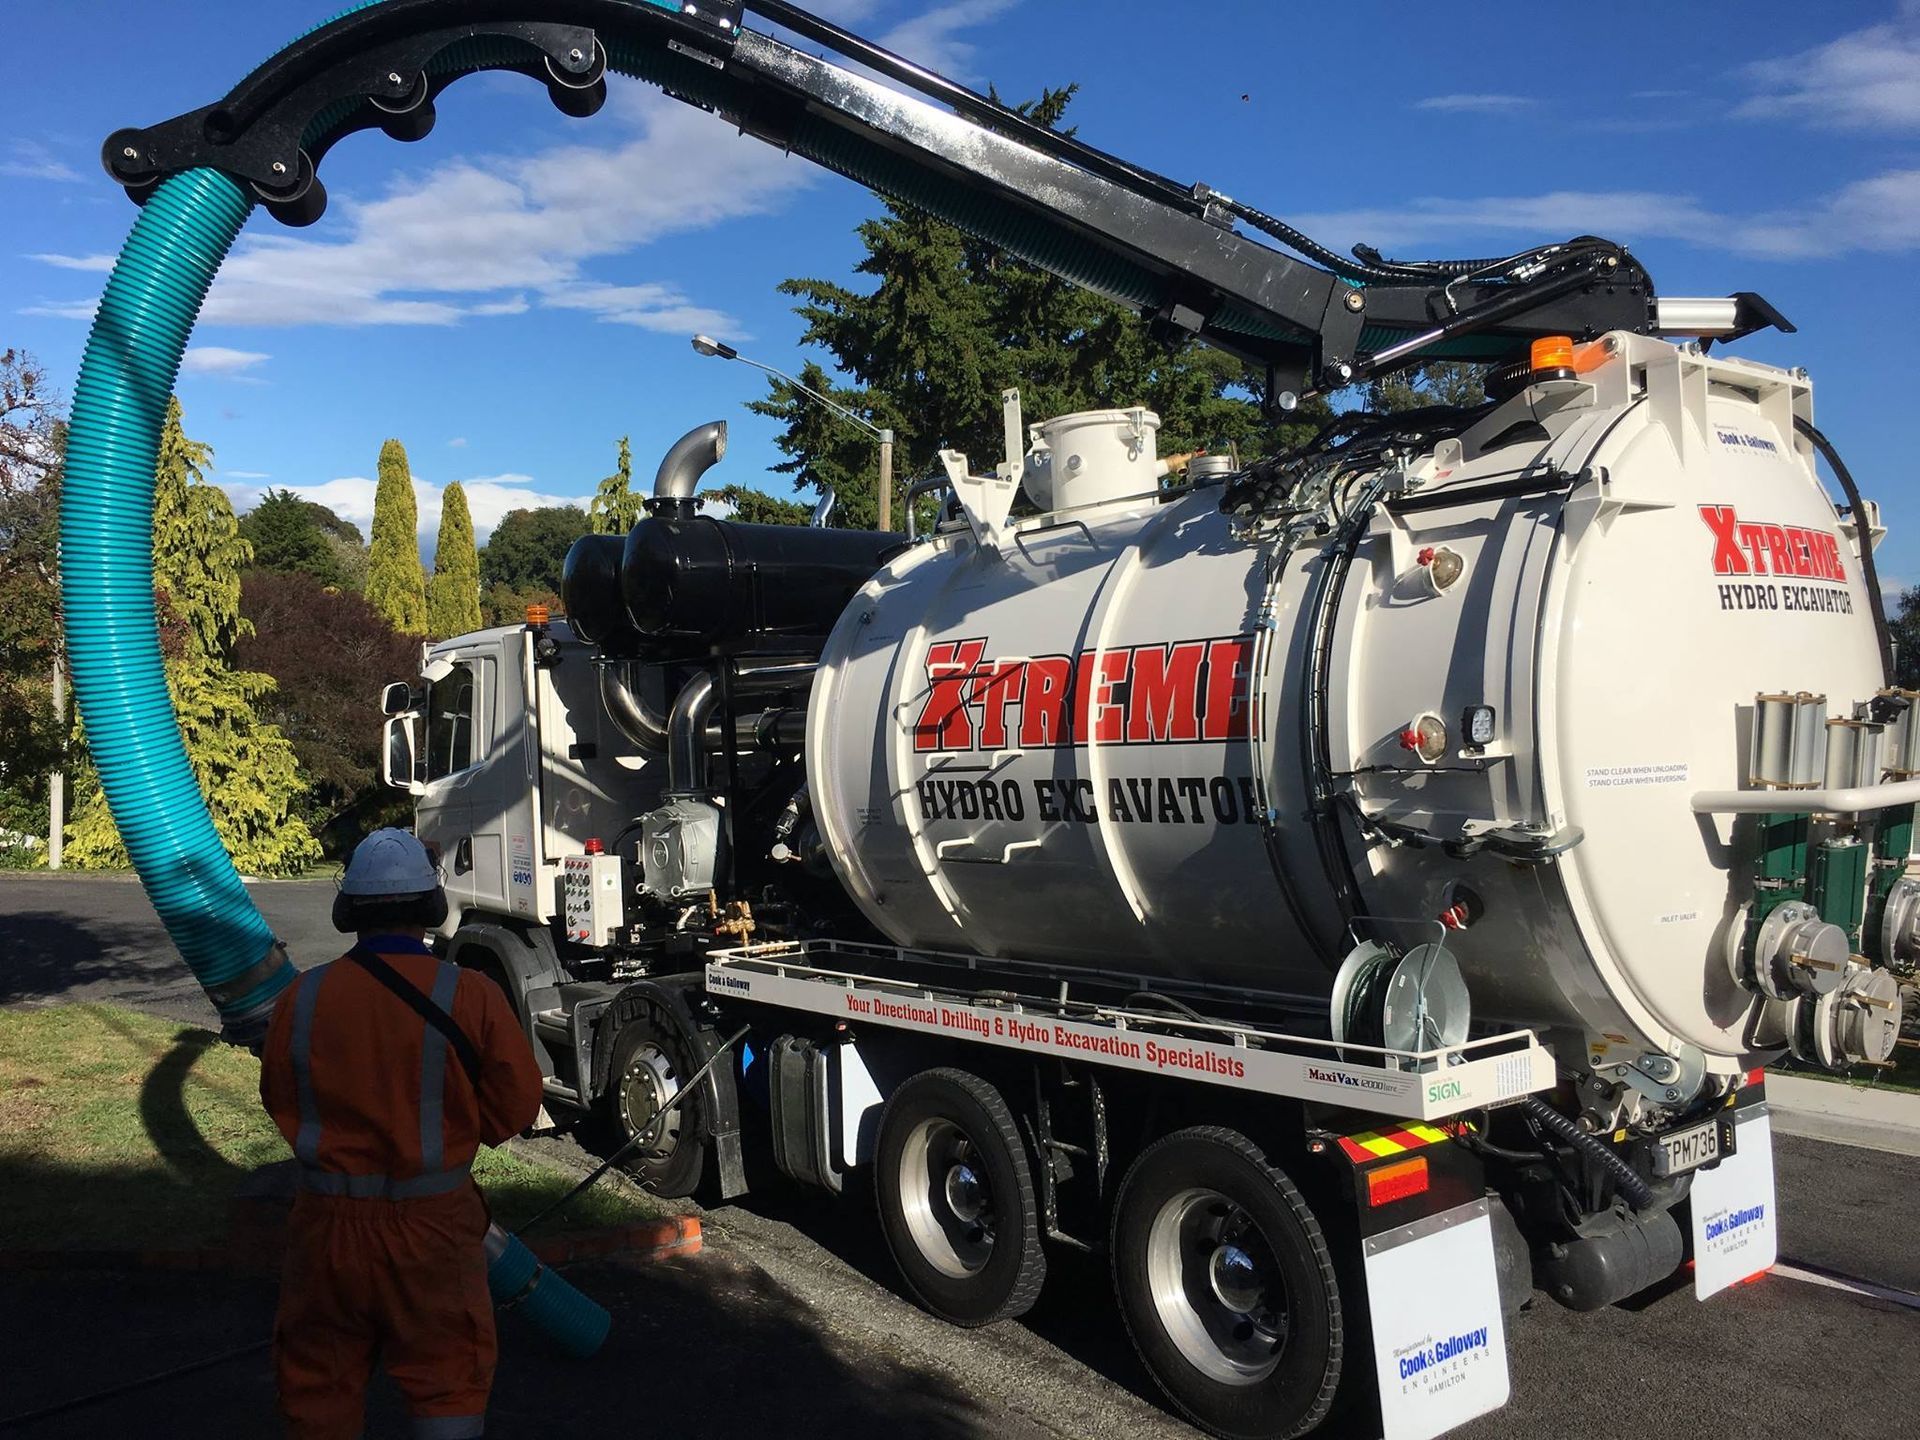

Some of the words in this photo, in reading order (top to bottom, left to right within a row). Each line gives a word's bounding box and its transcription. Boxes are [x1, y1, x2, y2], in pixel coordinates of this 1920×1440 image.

[1697, 504, 1847, 584] XTREME
[1718, 585, 1778, 611] HYDRO
[1784, 586, 1853, 615] EXCAVATOR
[914, 634, 1265, 753] XTREME
[1587, 768, 1609, 776] STAND
[1611, 767, 1631, 776] CLEAR
[1633, 766, 1652, 774] WHEN
[1589, 779, 1611, 787] STAND
[1613, 778, 1633, 786] CLEAR
[1634, 776, 1653, 785] WHEN
[916, 778, 1024, 823] HYDRO
[846, 994, 870, 1014] Your
[874, 999, 938, 1024] Directional
[941, 1008, 990, 1037] Drilling
[995, 1017, 1003, 1035] &
[1008, 1019, 1050, 1043] Hydro
[1054, 1026, 1141, 1059] Excavation
[1146, 1041, 1245, 1078] Specialists
[1309, 1068, 1359, 1087] MaxiVax
[1428, 1080, 1460, 1103] SIGN
[1403, 1349, 1490, 1394] ENGINEERS
[1429, 1372, 1466, 1395] HAMILTON
